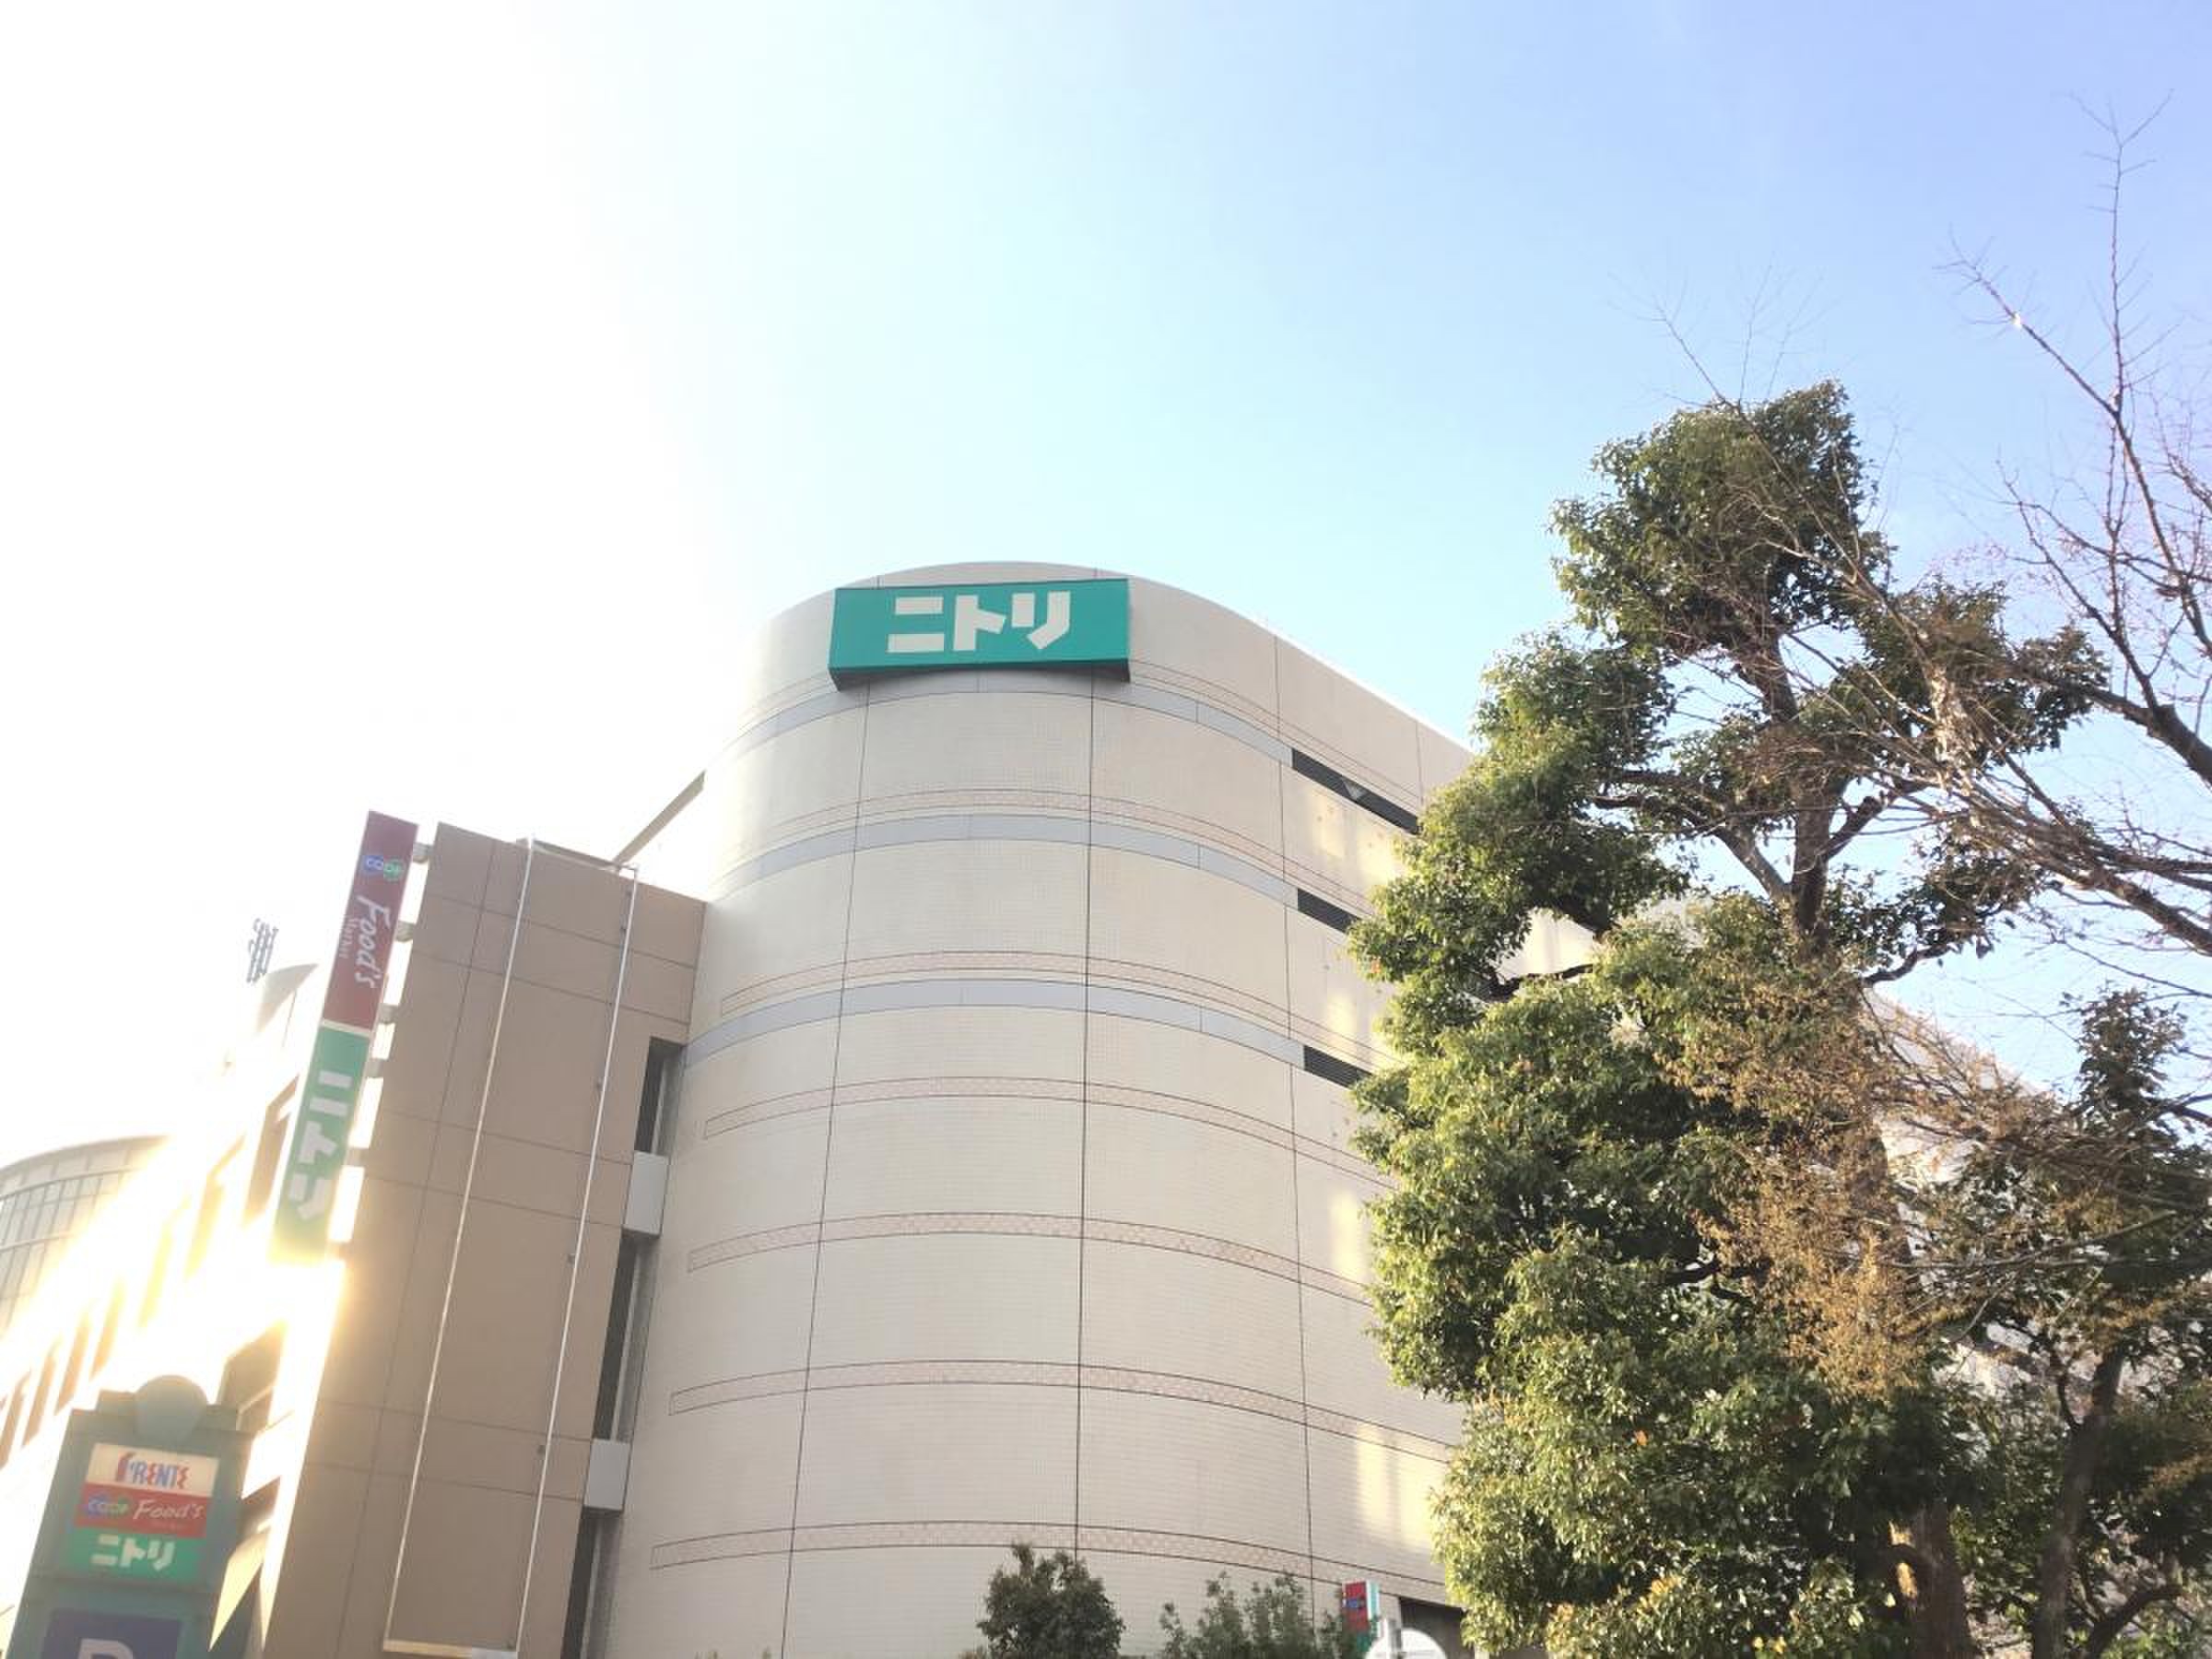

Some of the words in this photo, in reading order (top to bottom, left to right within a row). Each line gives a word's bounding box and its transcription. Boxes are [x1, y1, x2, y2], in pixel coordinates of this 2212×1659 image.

[885, 590, 1072, 653] ニトリ
[355, 895, 391, 989] Food's
[288, 1069, 353, 1220] ニトリ
[132, 1498, 205, 1520] Food's
[89, 1534, 175, 1571] ニトリ
